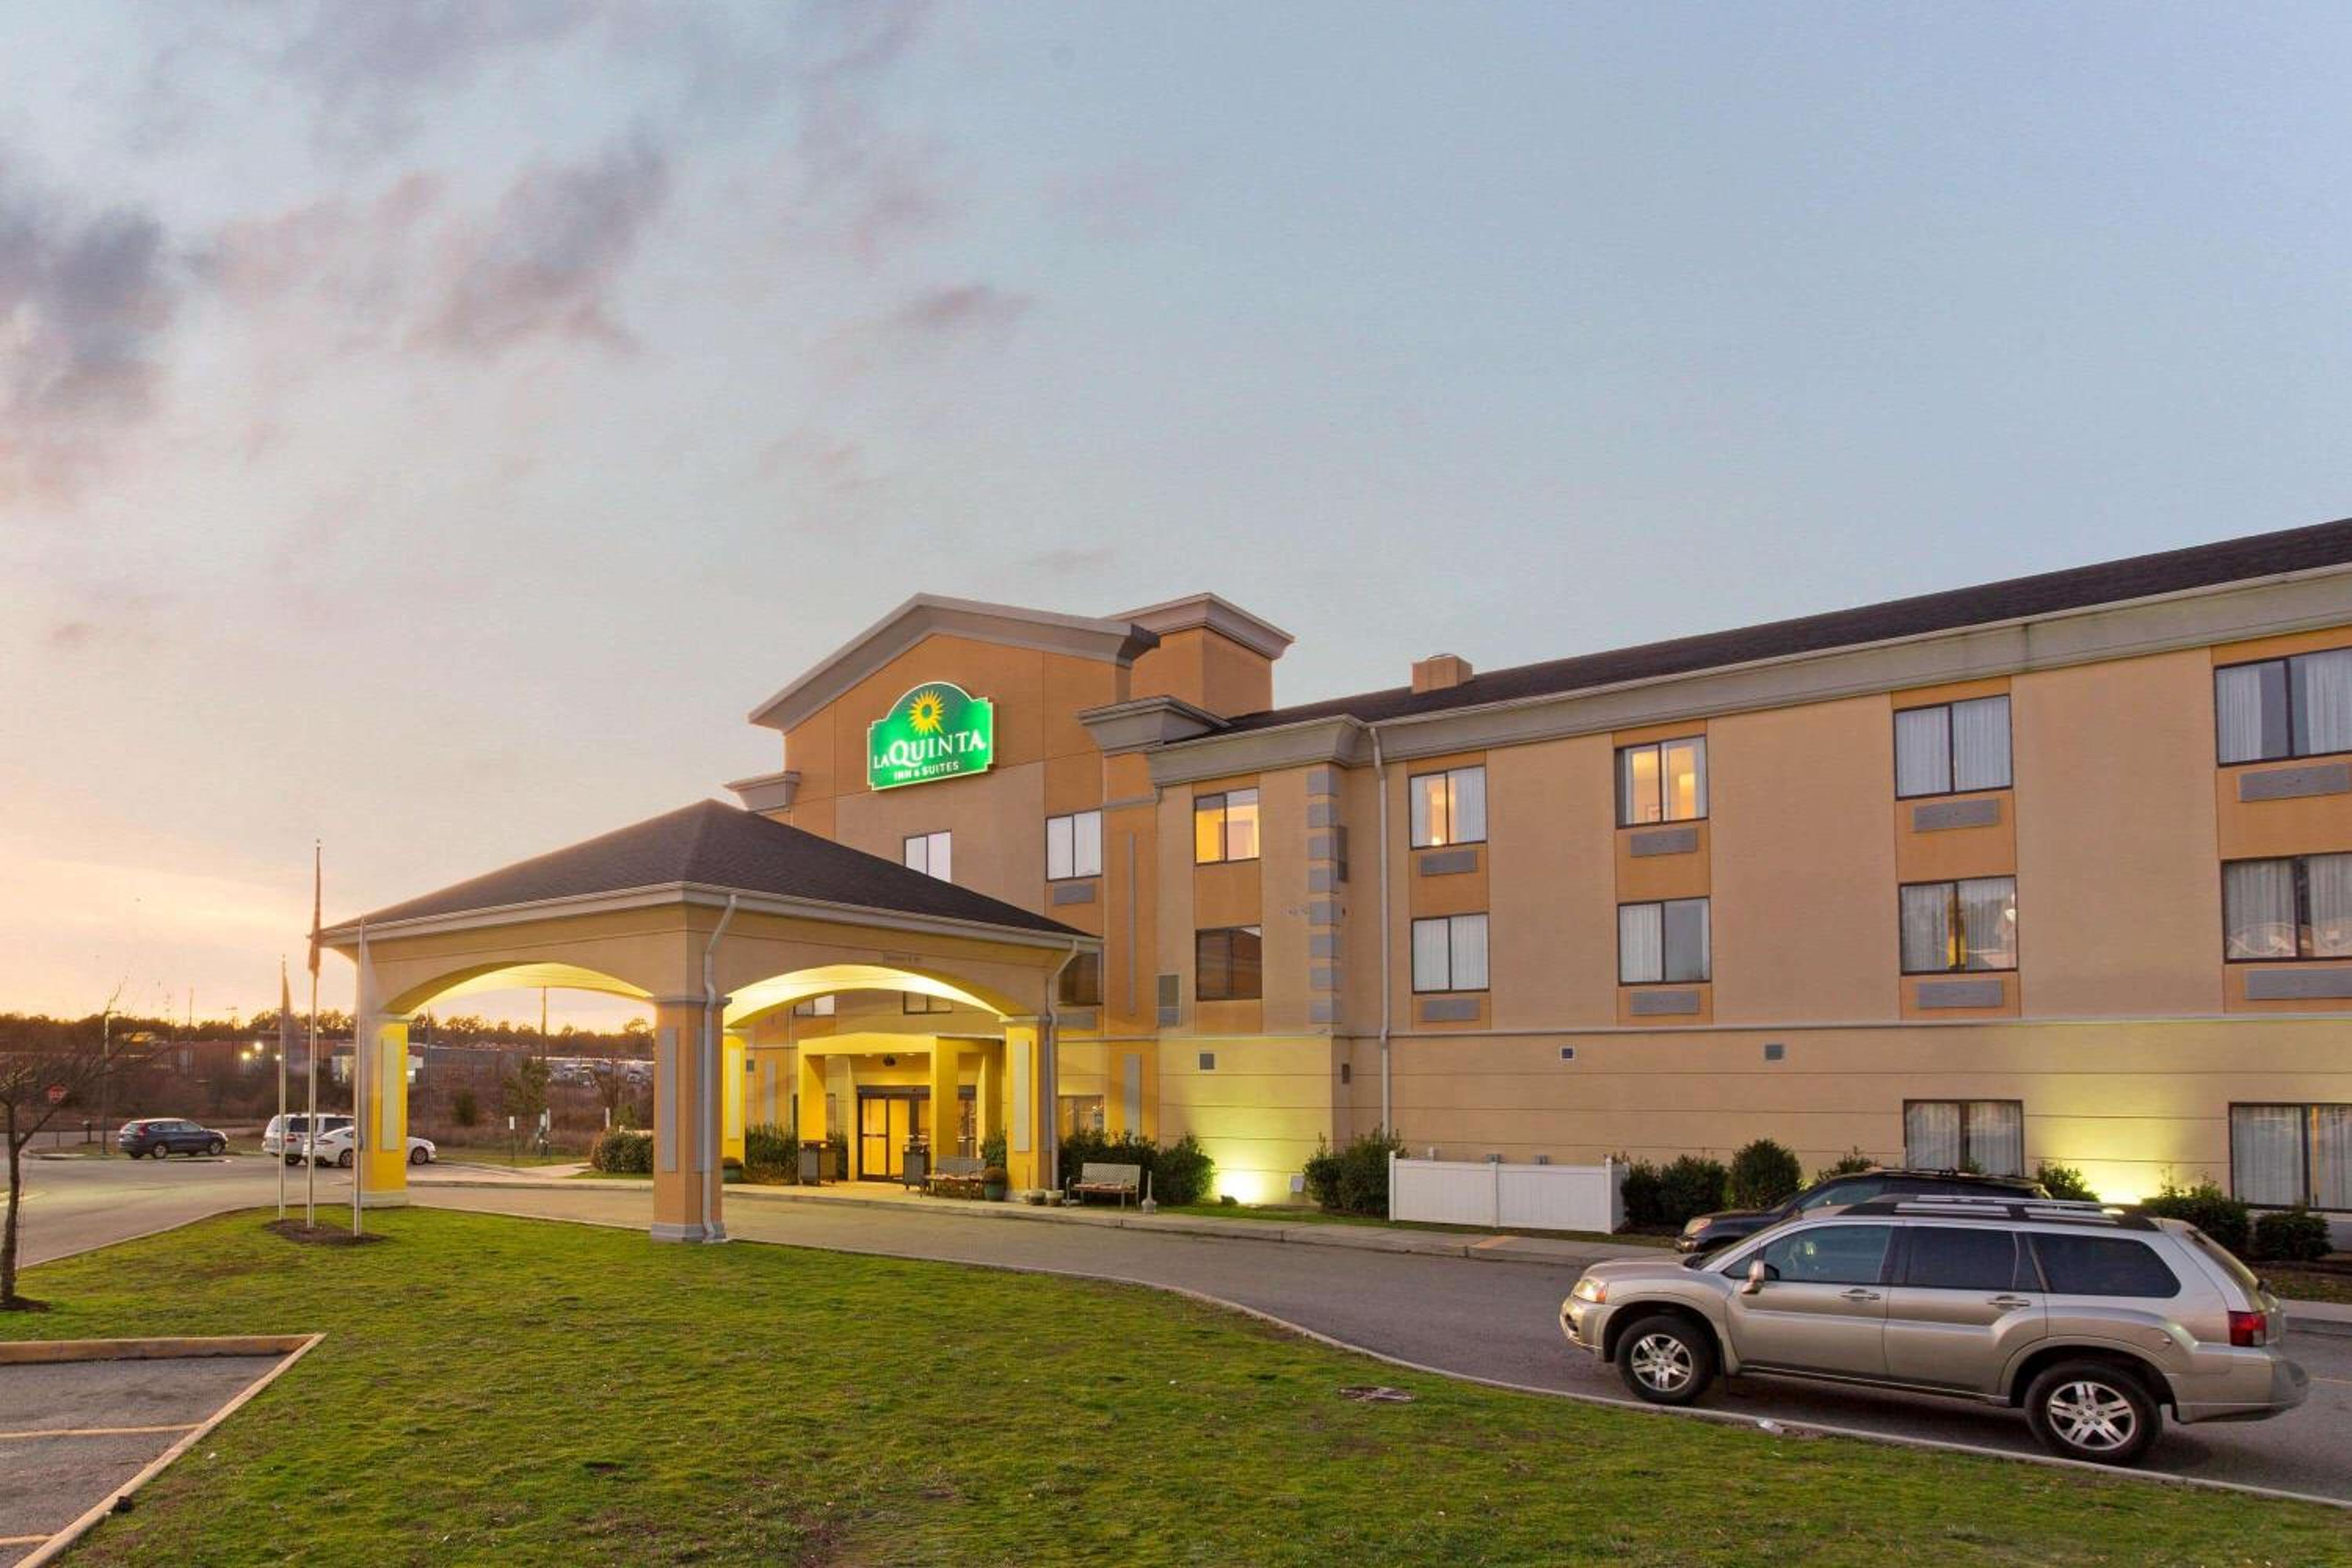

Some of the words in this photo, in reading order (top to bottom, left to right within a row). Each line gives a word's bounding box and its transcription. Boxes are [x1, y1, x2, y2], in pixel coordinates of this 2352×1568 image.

[874, 754, 890, 768] LA
[889, 729, 986, 768] QUINTA
[895, 769, 912, 781] INN
[922, 760, 959, 776] SUITES
